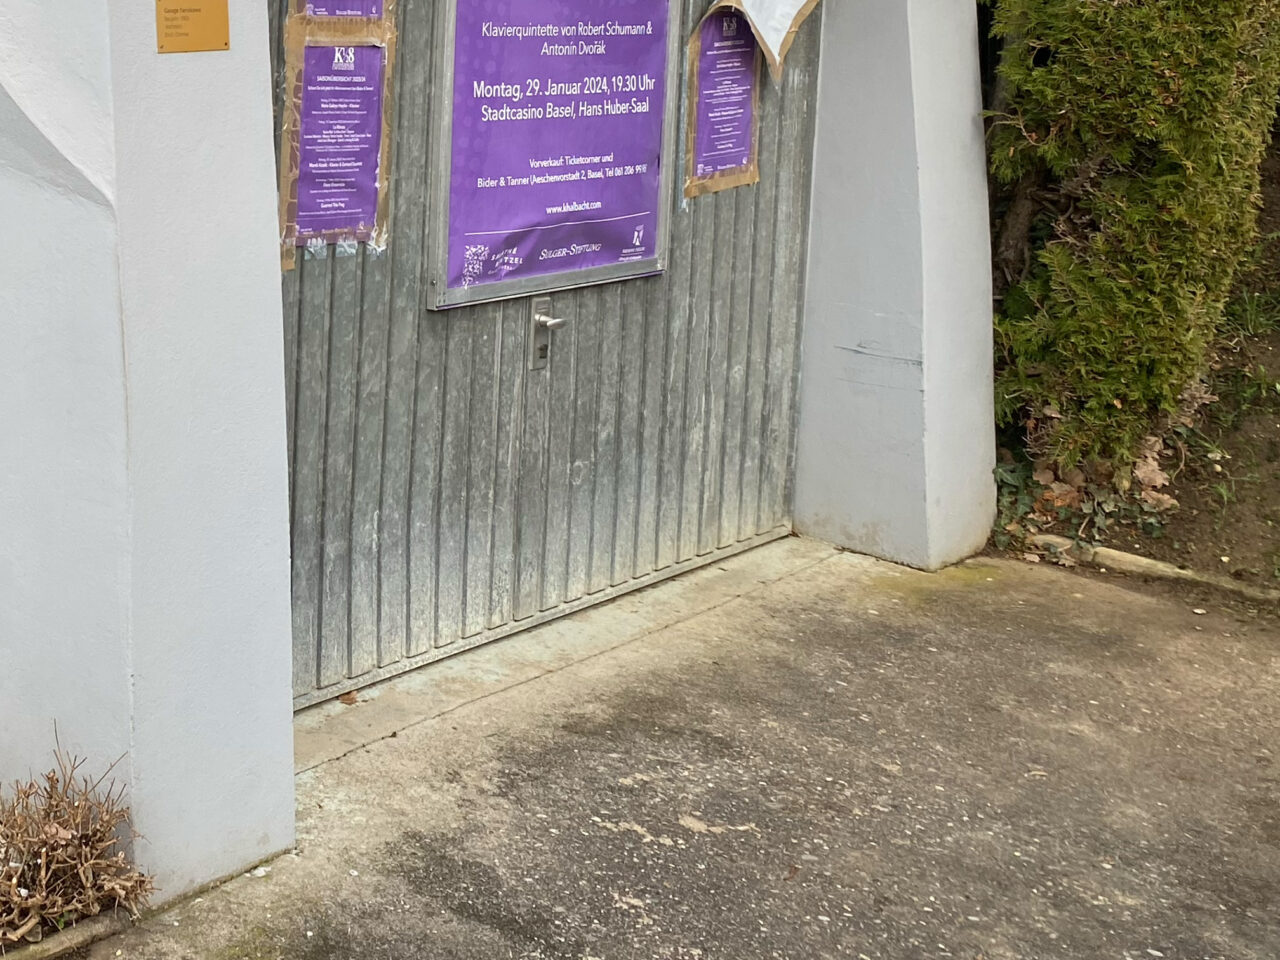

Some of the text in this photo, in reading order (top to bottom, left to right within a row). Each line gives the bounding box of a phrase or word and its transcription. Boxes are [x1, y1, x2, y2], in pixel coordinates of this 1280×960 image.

[482, 22, 652, 40] Klavierquintette von Robert Schumann &
[541, 41, 606, 56] Antonín Dvořák
[474, 74, 655, 101] Montag, 29. Januar 2024, 19.30 Uhr
[482, 99, 649, 122] Stadtcasino Basel, Hans Huber-Saal
[565, 155, 600, 166] Ticketcorner
[602, 152, 613, 163] und
[478, 178, 498, 188] Bider
[500, 178, 506, 186] &
[508, 176, 529, 186] Tanner
[624, 166, 634, 175] 206
